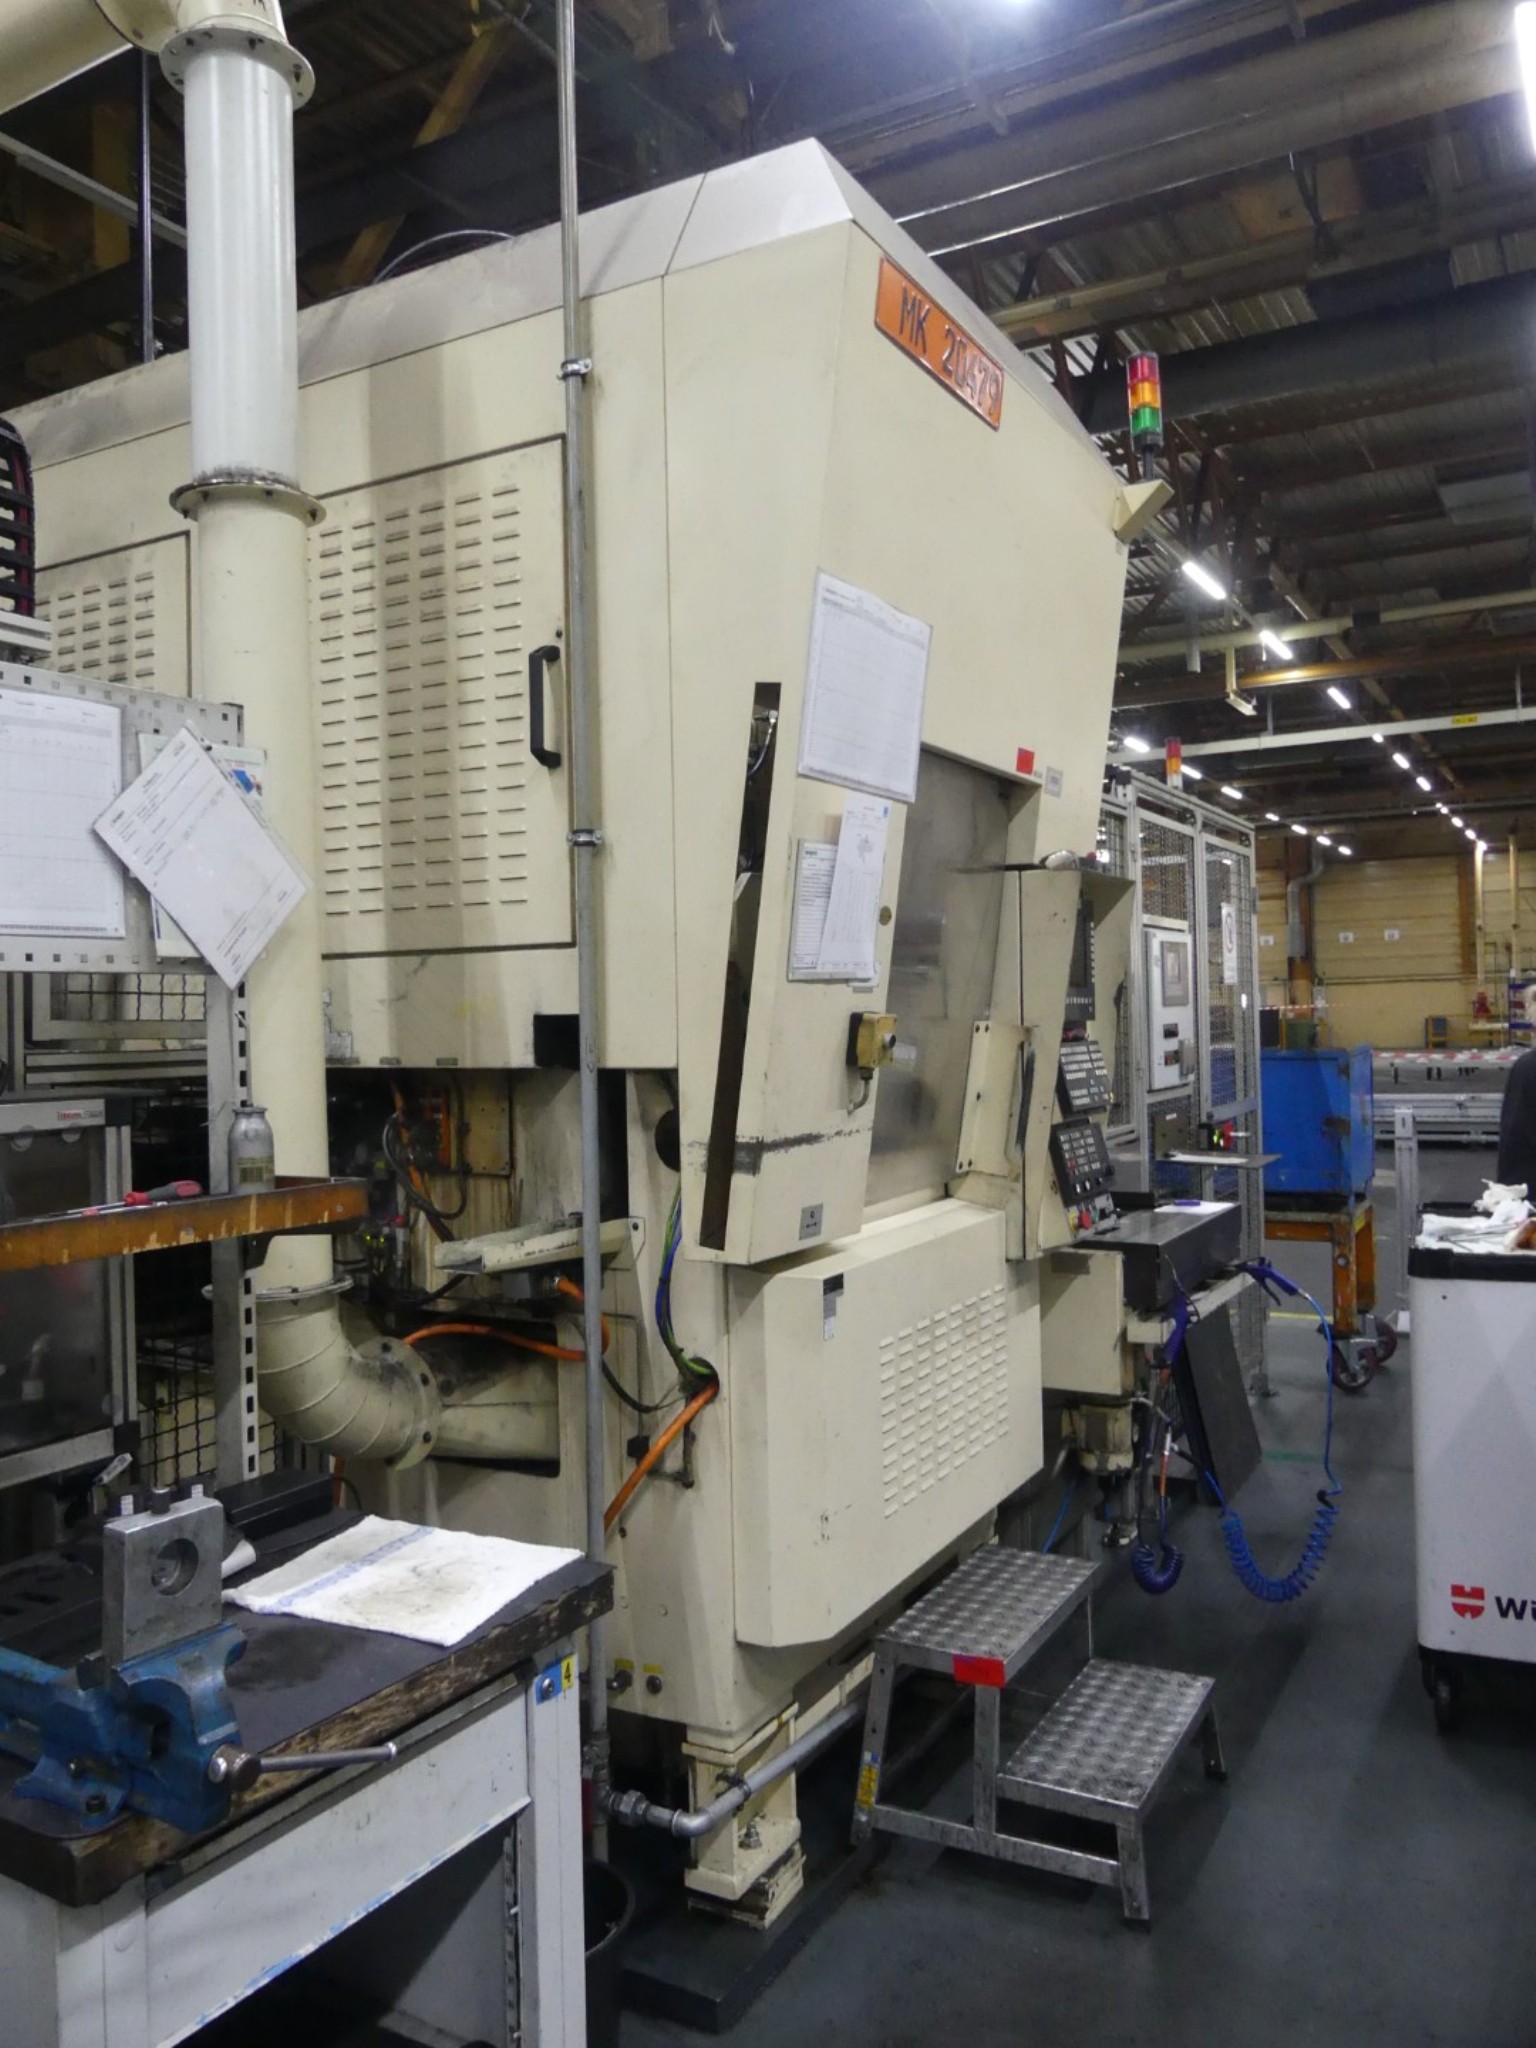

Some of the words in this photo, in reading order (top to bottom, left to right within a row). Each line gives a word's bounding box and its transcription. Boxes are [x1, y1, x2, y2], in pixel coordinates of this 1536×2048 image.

[898, 283, 930, 353] MK
[1494, 1596, 1536, 1622] W
[564, 1661, 572, 1683] 4
